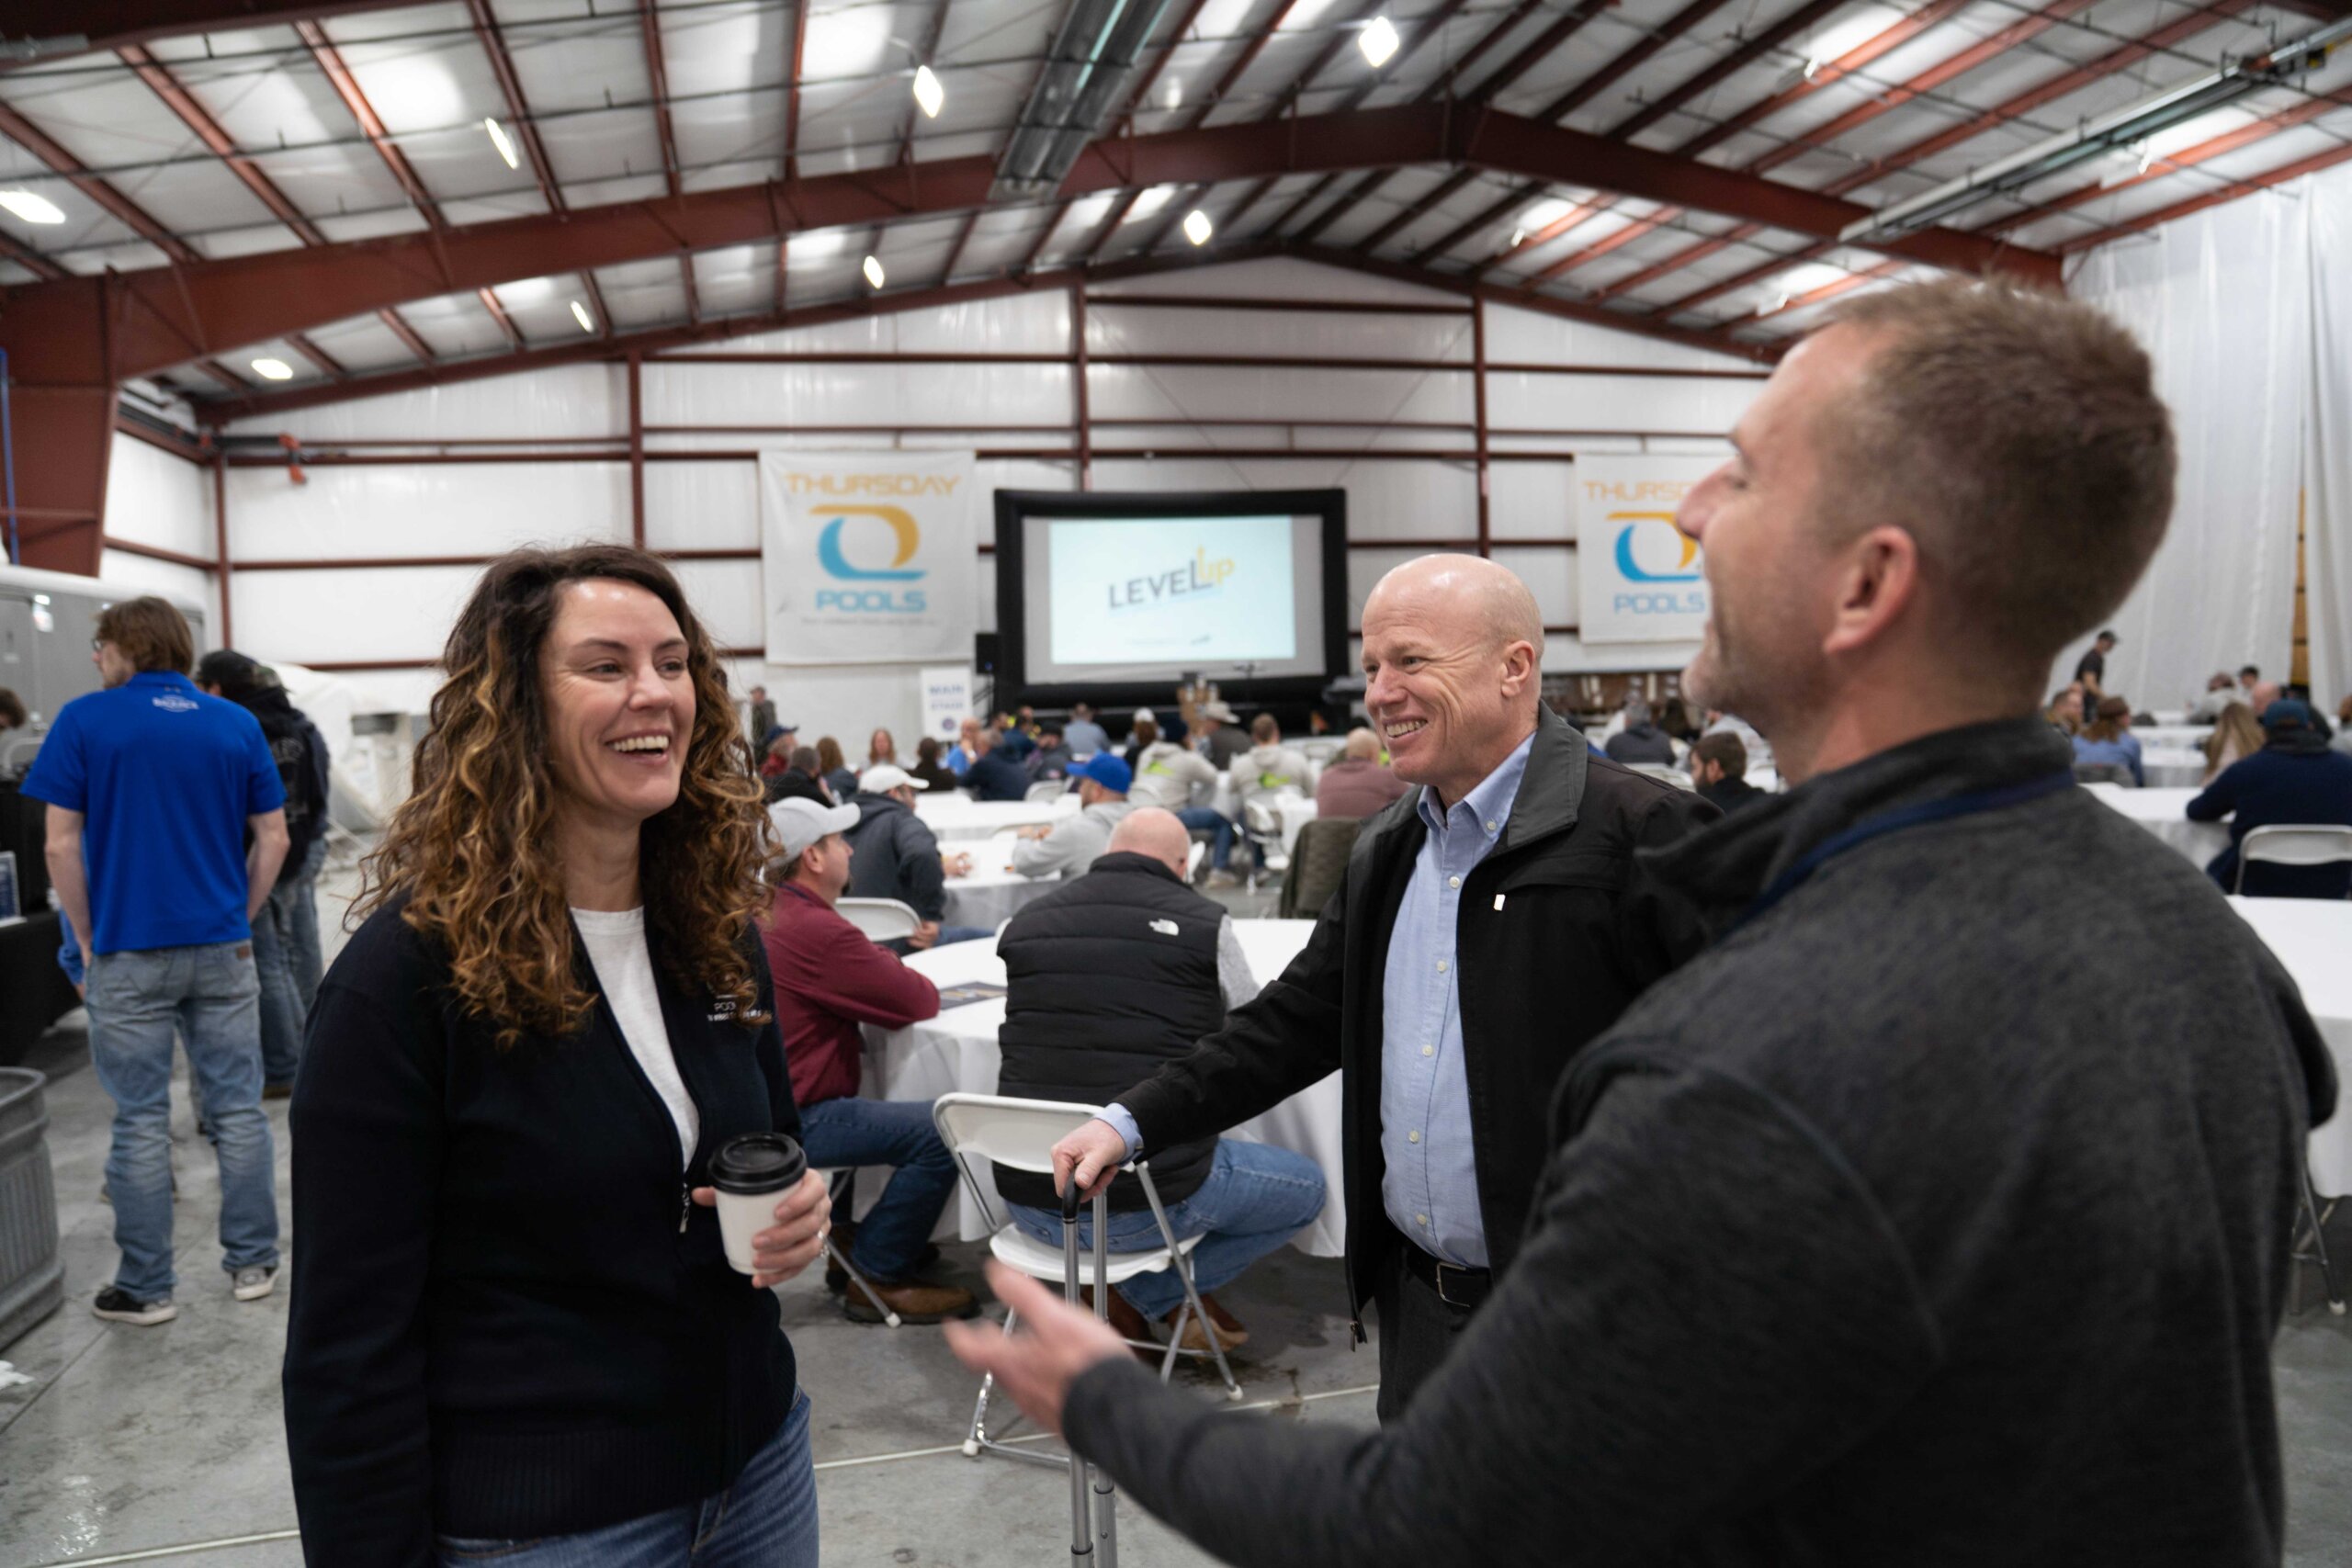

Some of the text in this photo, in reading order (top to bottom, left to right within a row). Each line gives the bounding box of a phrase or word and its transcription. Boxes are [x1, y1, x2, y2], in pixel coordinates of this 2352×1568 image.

[786, 473, 961, 497] THURSDAY
[1108, 559, 1214, 610] LEVEL
[815, 589, 927, 613] POOLS
[1613, 592, 1706, 615] POOLS
